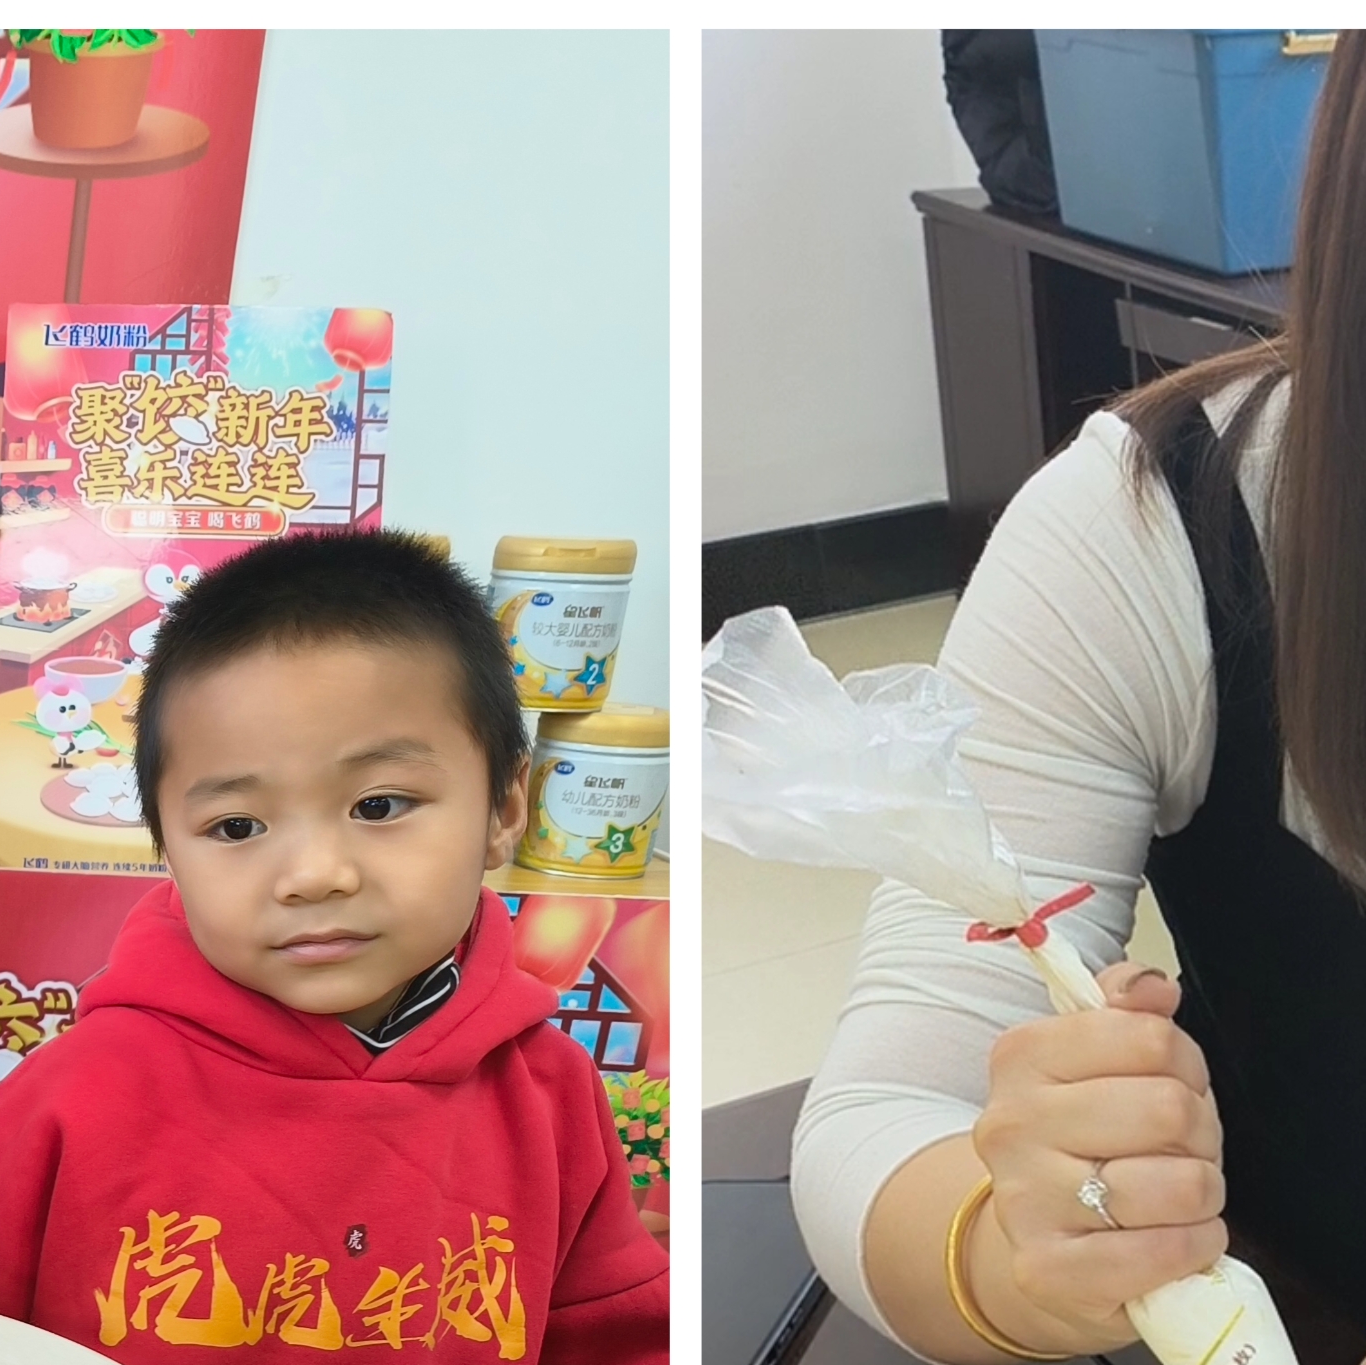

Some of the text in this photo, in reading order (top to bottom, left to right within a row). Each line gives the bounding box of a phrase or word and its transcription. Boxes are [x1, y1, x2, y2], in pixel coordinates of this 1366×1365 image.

[44, 323, 149, 348] 飞鹤奶粉
[81, 448, 316, 508] 喜乐连连
[208, 511, 262, 530] 喝飞鹤
[586, 663, 600, 686] 2
[561, 789, 641, 810] 幼儿配方奶粉
[609, 832, 625, 854] 3
[95, 1209, 527, 1361] 虎虎生威
